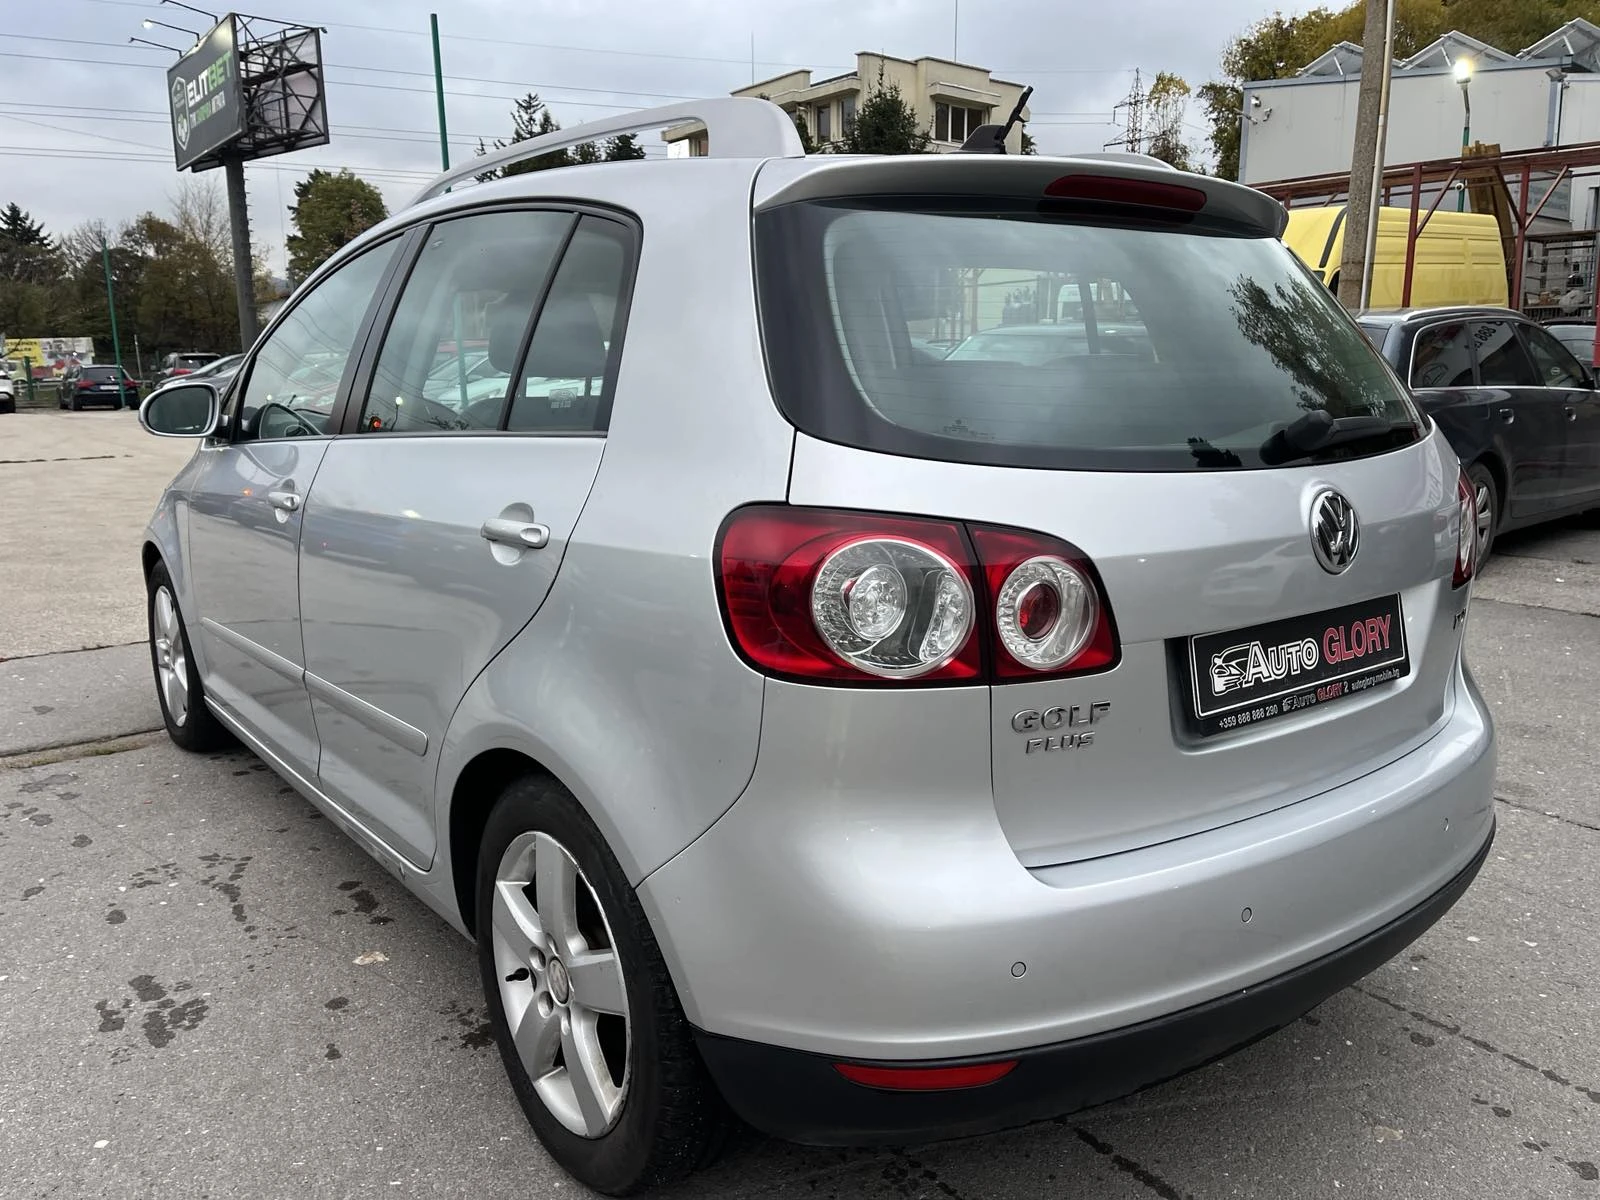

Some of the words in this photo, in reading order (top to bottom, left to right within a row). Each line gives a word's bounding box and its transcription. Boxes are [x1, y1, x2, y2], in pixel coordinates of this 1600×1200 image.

[1322, 614, 1391, 665] GLORY
[1011, 700, 1111, 733] GOLF
[1219, 714, 1237, 729] +359
[1238, 710, 1251, 723] 888
[1316, 682, 1343, 701] GLORY
[1025, 731, 1096, 754] PLUS
